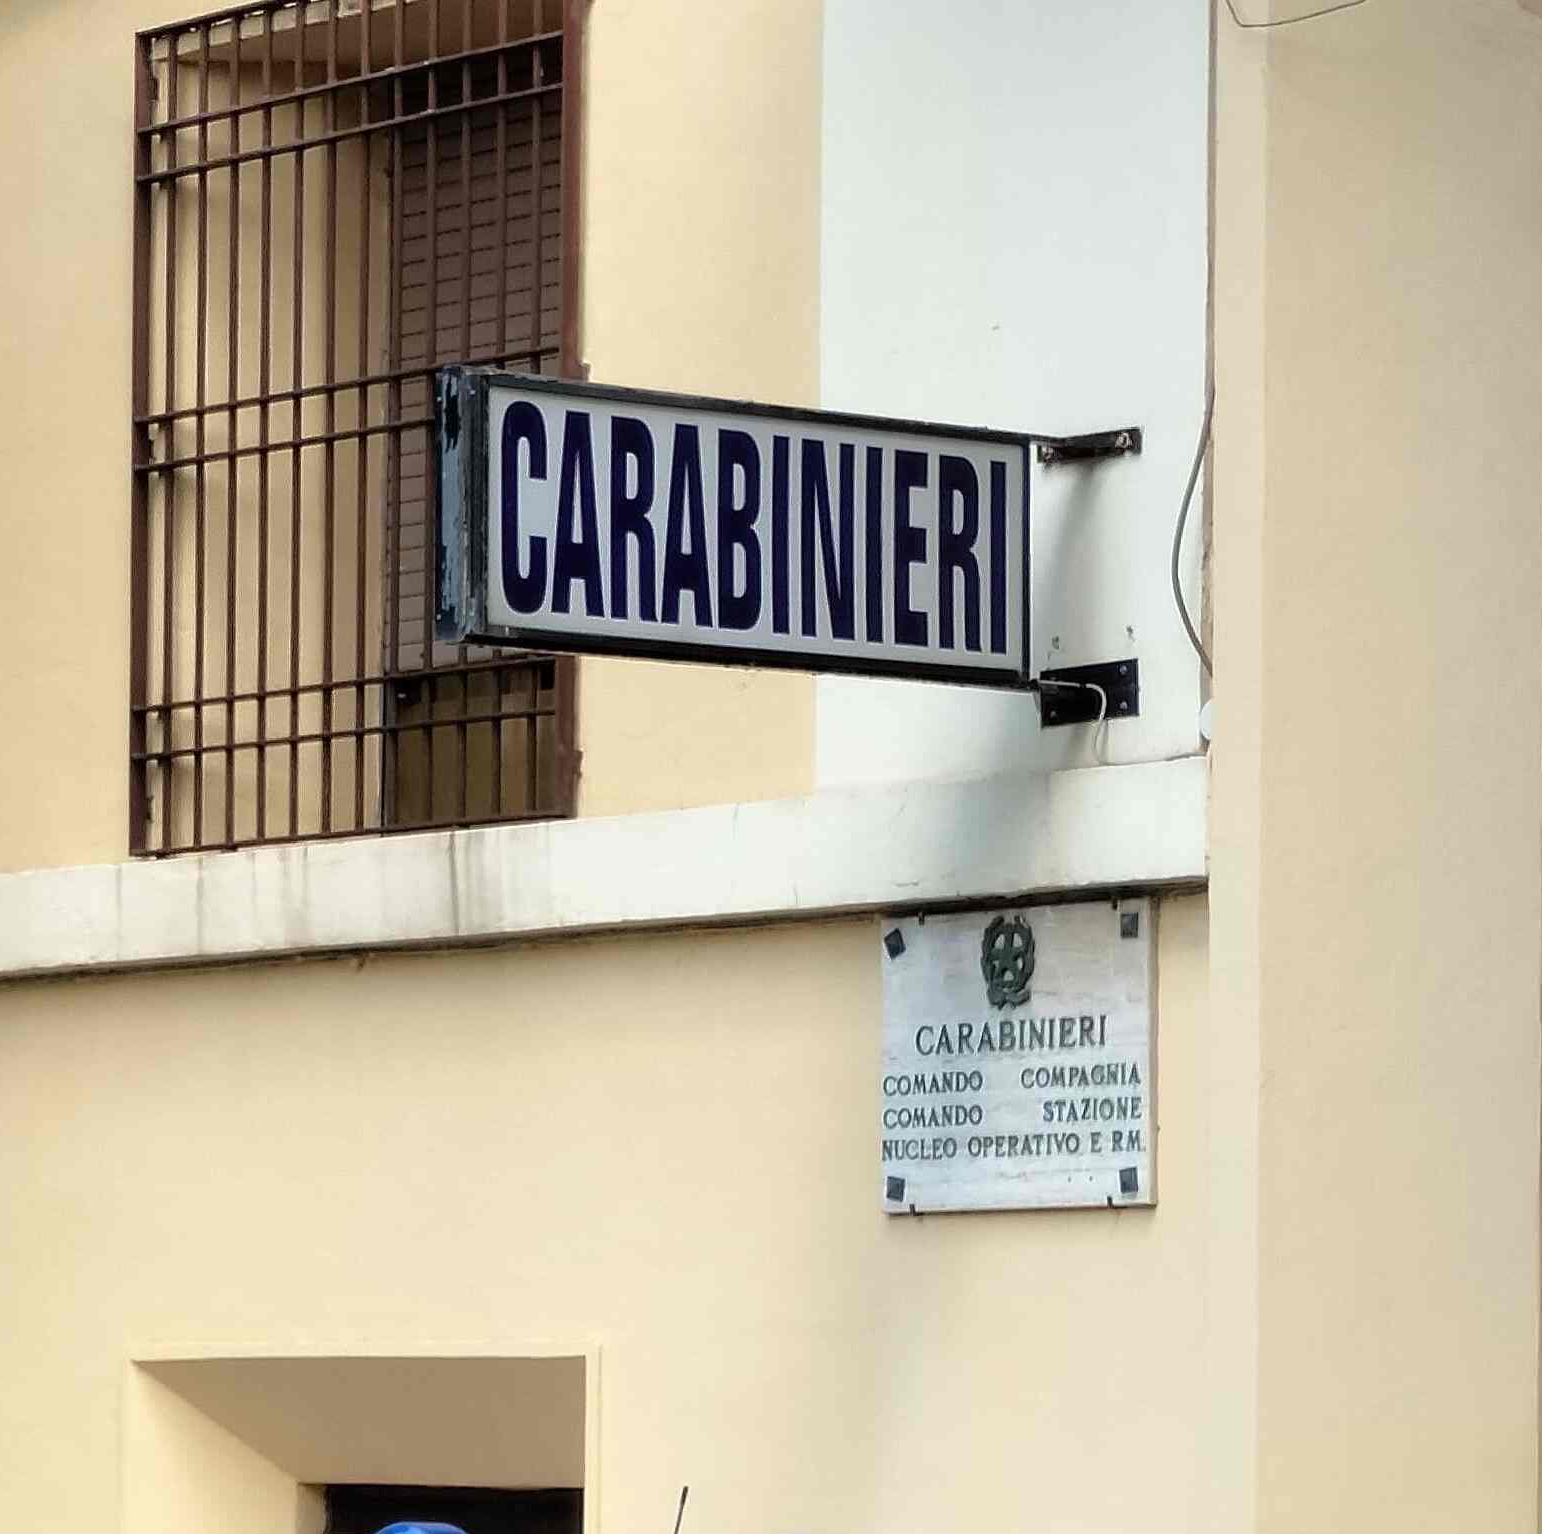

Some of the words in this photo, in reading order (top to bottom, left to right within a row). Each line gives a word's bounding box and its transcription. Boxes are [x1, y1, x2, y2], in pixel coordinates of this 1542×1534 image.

[500, 401, 1008, 654] CARABINIERI
[915, 1014, 1108, 1056] CARABINIERI
[883, 1070, 984, 1096] COMANDO
[1021, 1062, 1141, 1089] COMPAGNIA
[883, 1104, 983, 1129] COMANDO
[1042, 1096, 1142, 1123] STAZIONE
[881, 1137, 957, 1161] NUCLEO
[968, 1132, 1081, 1158] OPERATIVO
[1091, 1131, 1102, 1153] E
